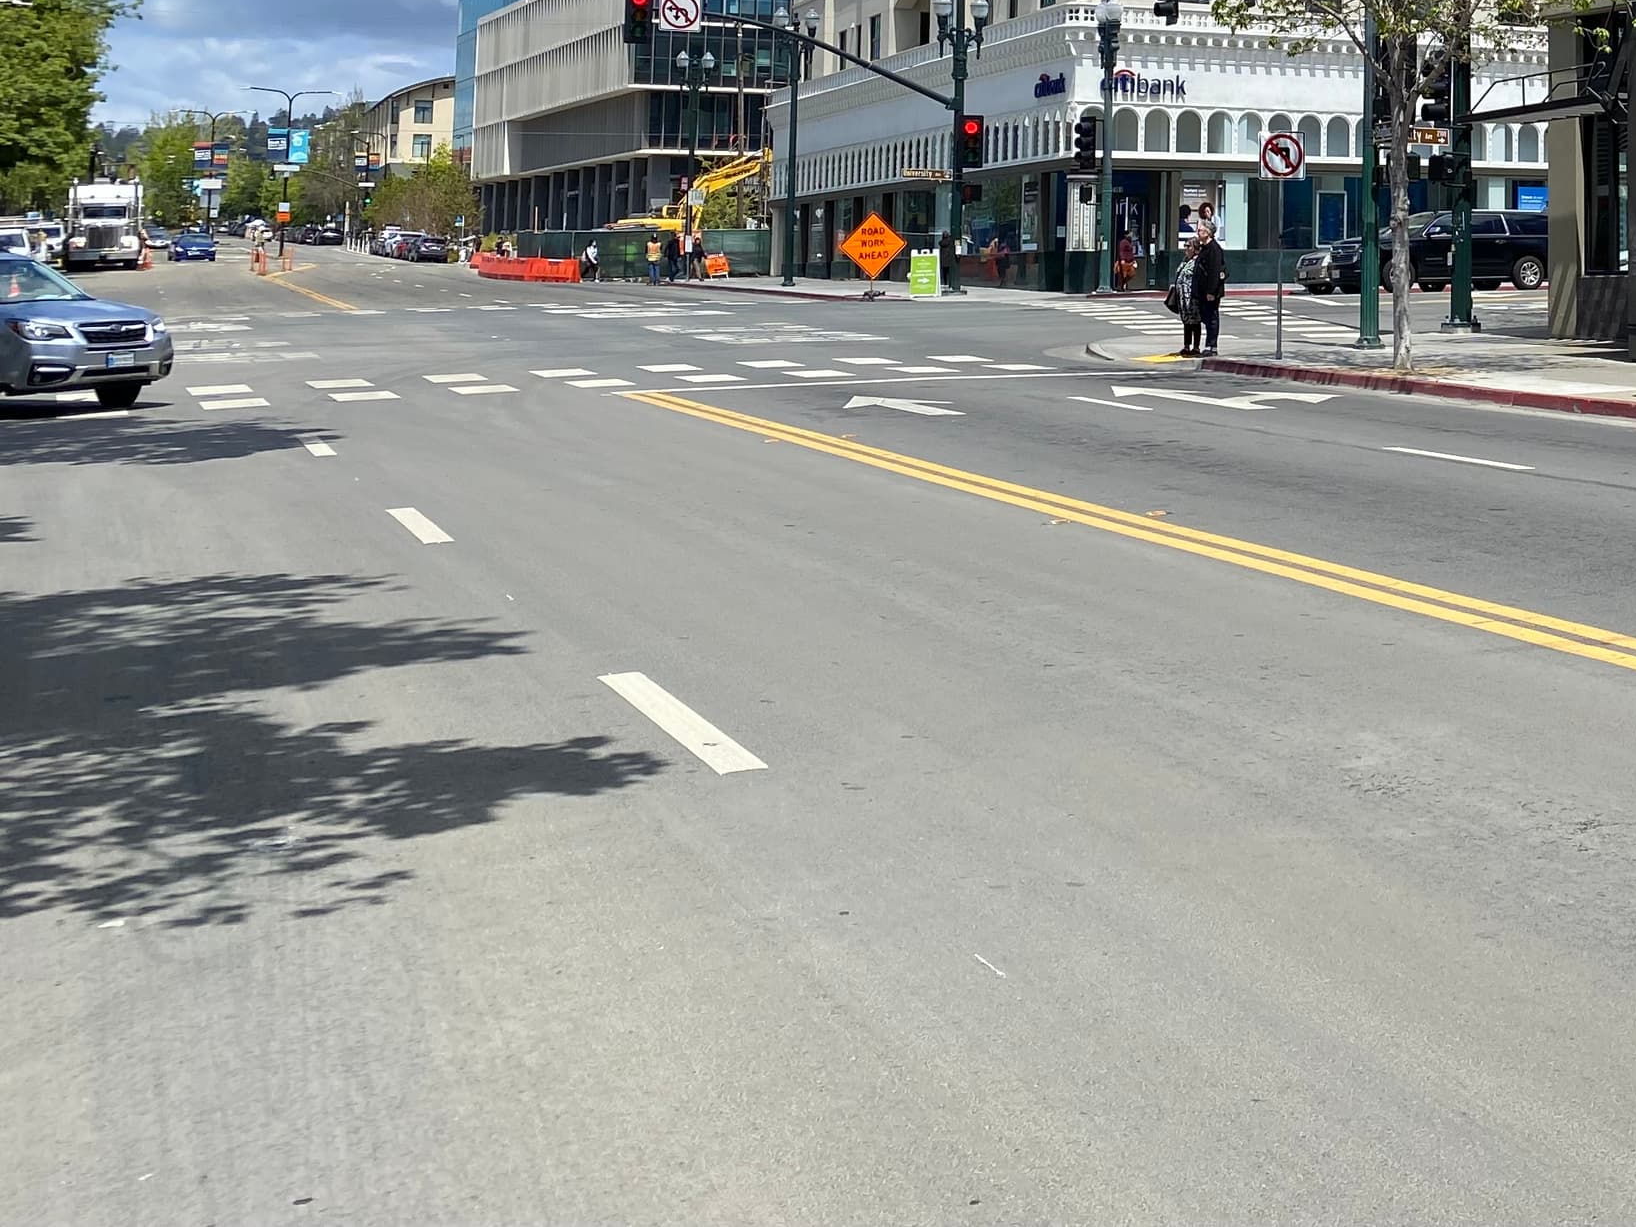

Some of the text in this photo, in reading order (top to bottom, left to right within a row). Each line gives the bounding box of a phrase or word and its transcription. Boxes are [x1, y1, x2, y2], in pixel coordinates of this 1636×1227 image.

[861, 227, 885, 236] ROAD
[861, 239, 885, 248] WORK
[858, 251, 889, 260] AHEAD
